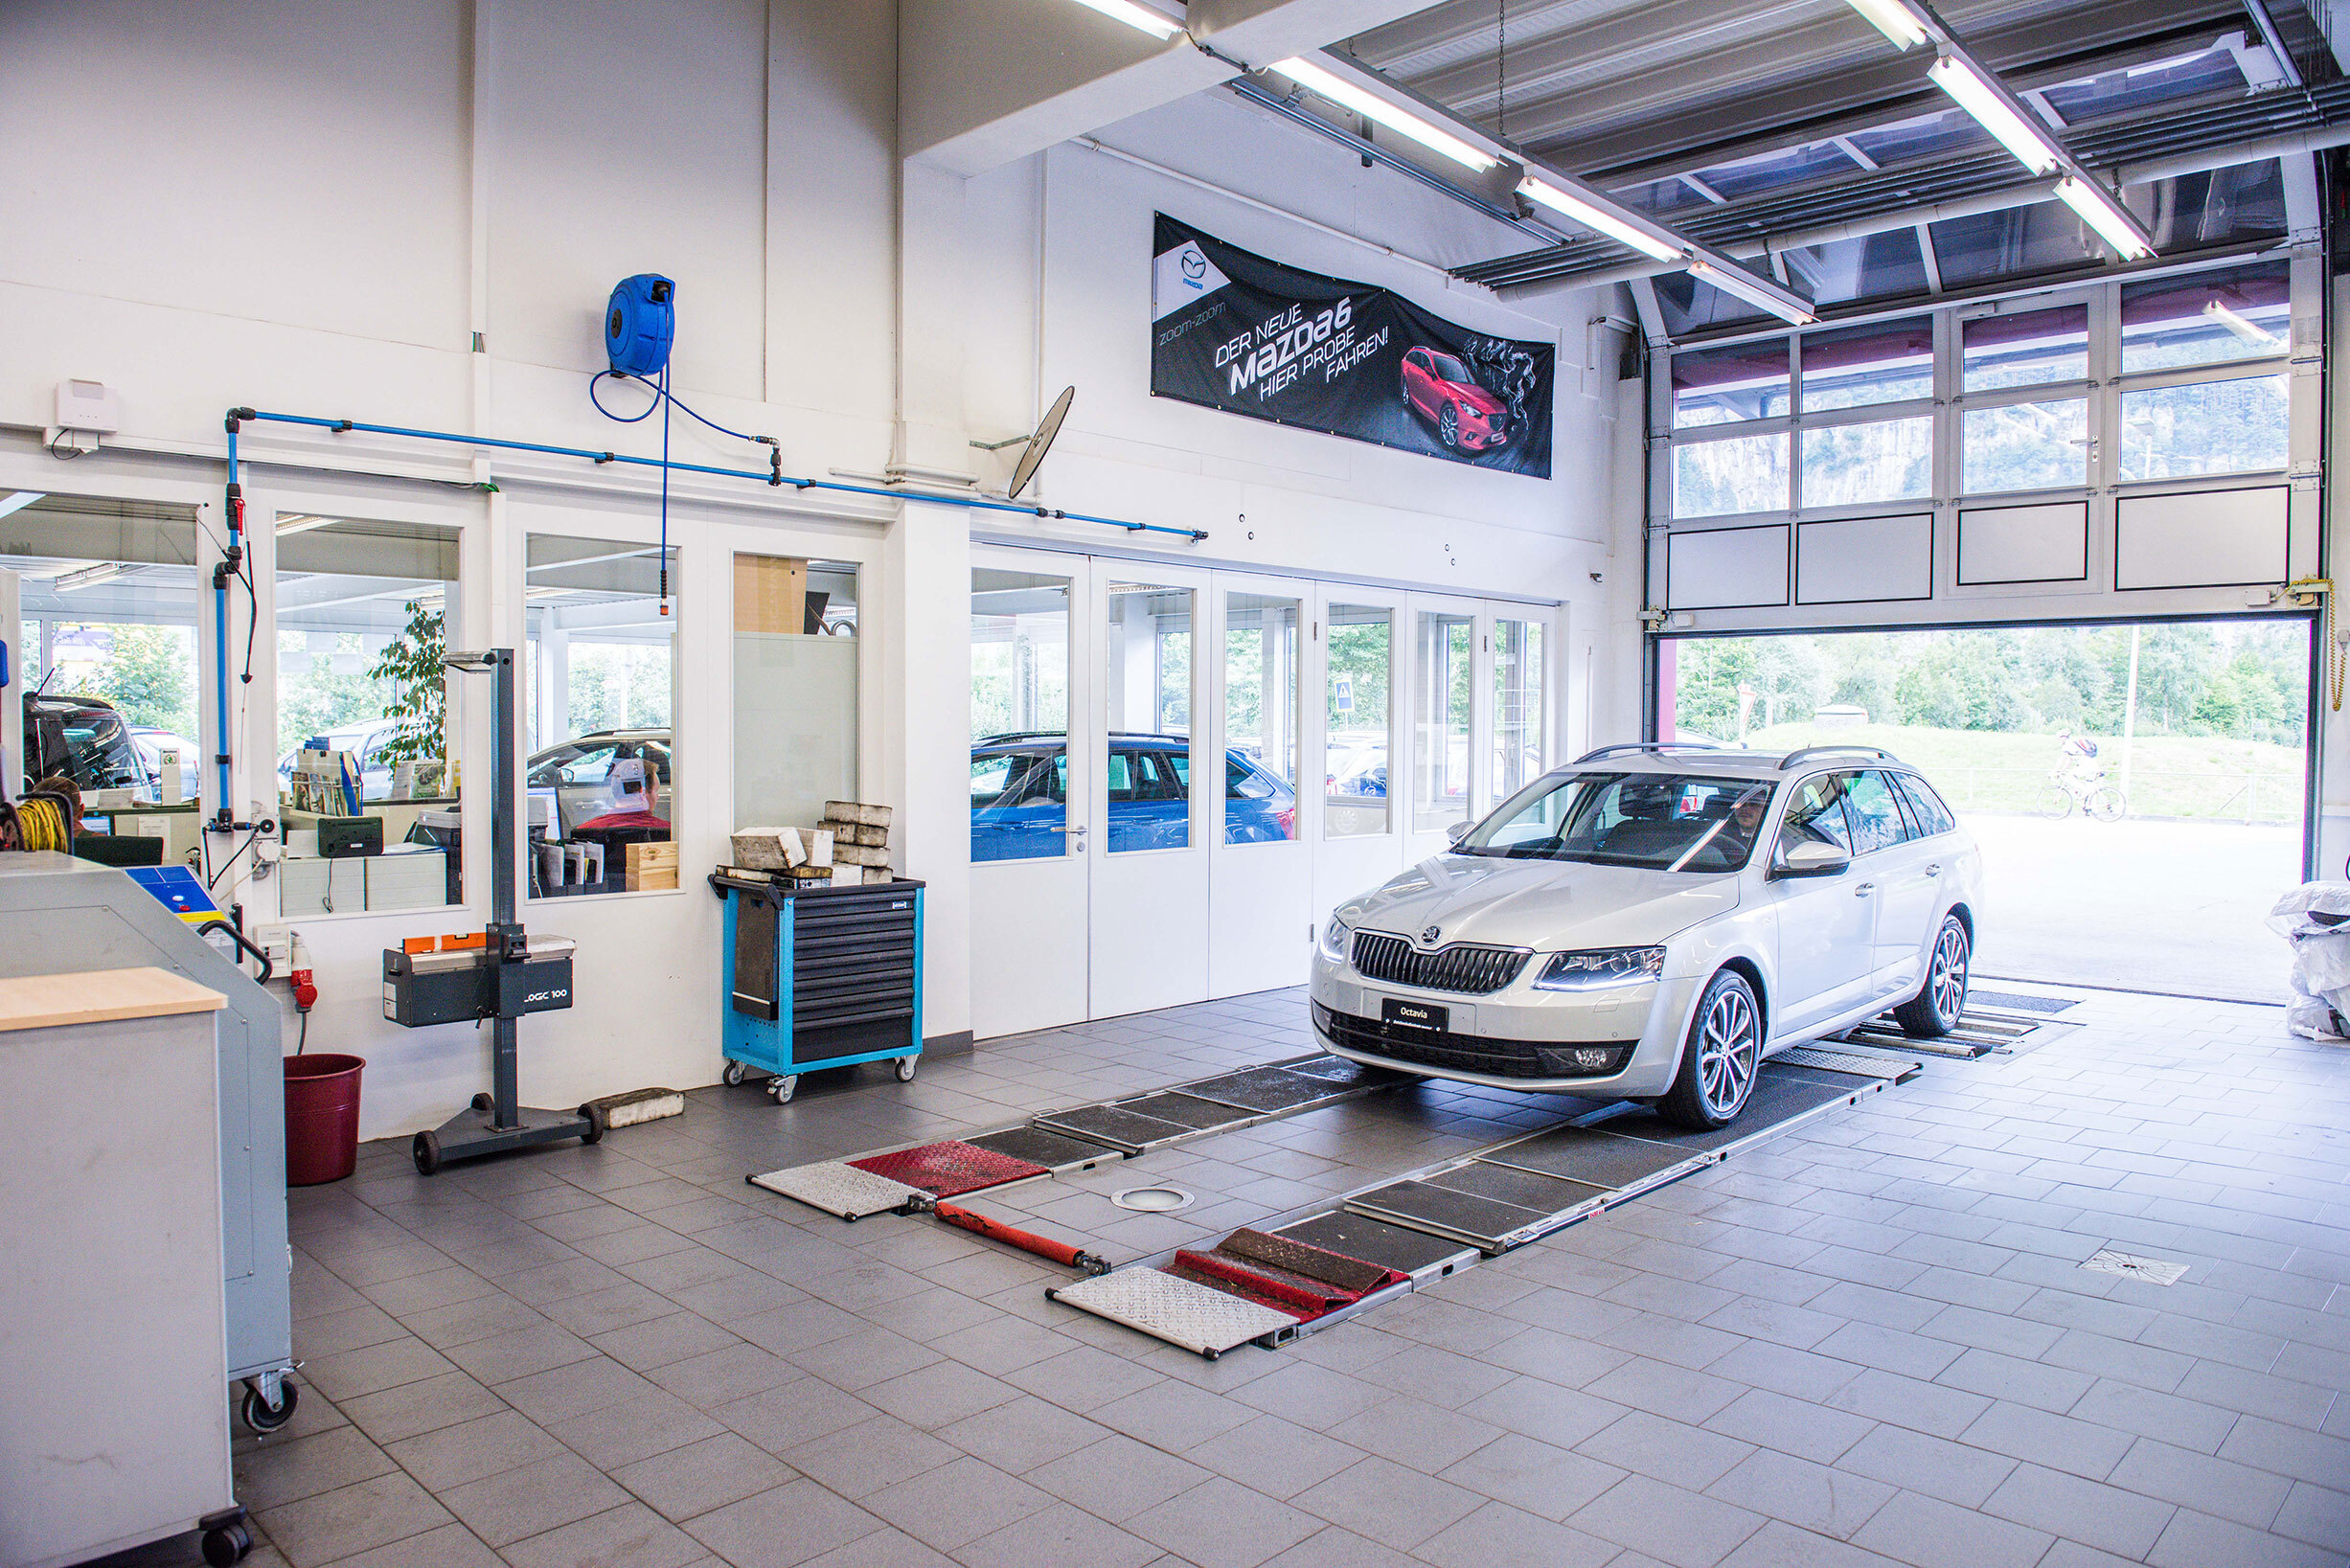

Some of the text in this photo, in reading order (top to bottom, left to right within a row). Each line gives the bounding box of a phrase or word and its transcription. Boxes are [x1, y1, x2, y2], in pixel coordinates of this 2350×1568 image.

[1159, 302, 1226, 346] zoom-zoom
[1215, 303, 1303, 369] DER NEUE
[1260, 325, 1356, 402] HIER PROBE
[1326, 326, 1389, 383] FAHREN!
[551, 989, 567, 999] 100
[1400, 1007, 1428, 1019] Octavia
